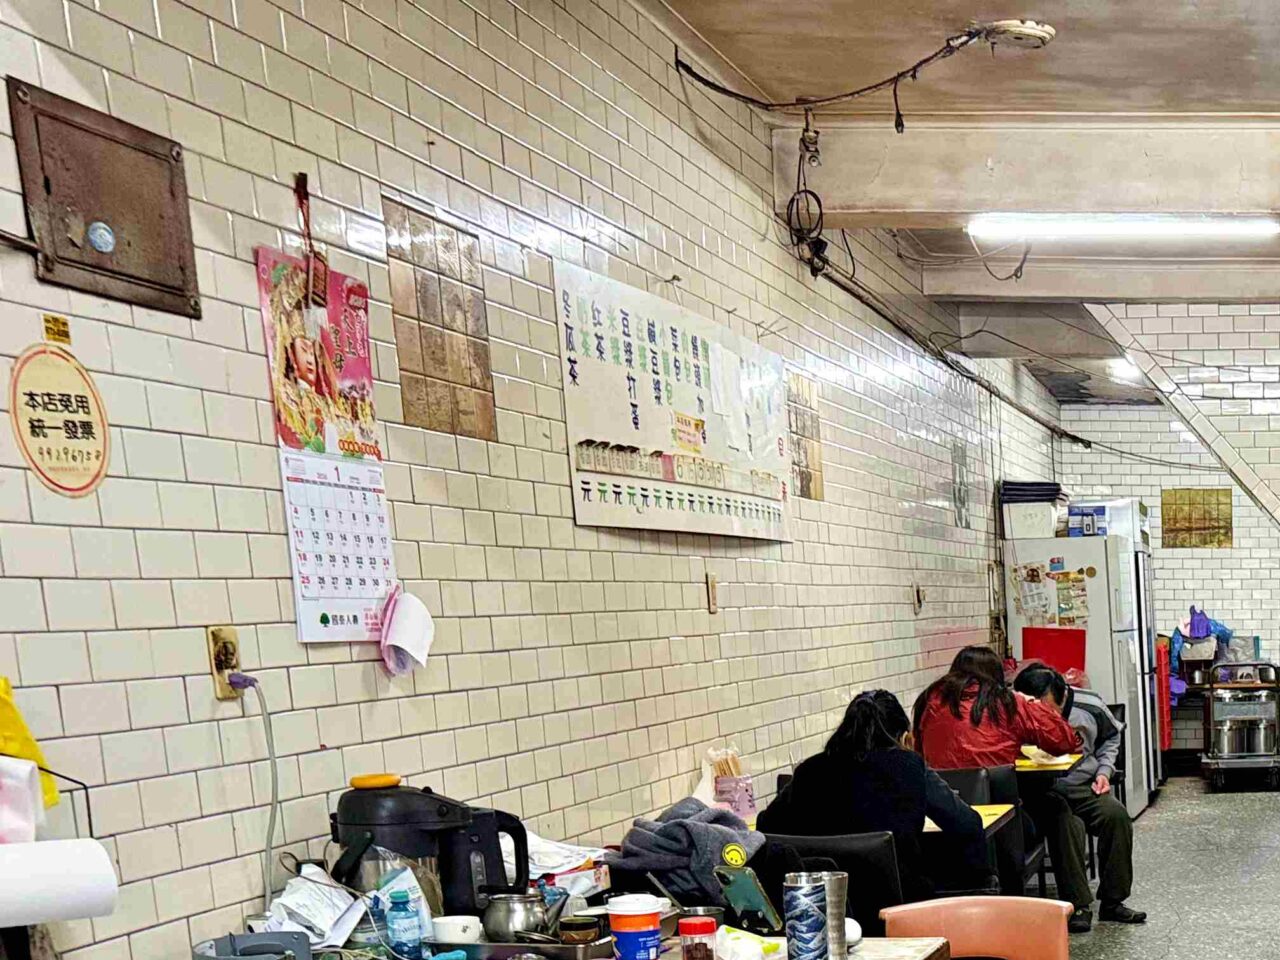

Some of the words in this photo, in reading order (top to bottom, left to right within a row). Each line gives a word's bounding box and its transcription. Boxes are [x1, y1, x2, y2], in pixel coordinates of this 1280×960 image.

[562, 289, 579, 386] 冬瓜茶
[591, 300, 606, 362] 紅茶
[23, 391, 91, 416] 本店免用
[28, 417, 96, 440] 統一發票
[333, 466, 341, 482] 1
[349, 491, 354, 500] 1
[362, 492, 367, 501] 2
[376, 494, 380, 502] 3
[581, 480, 591, 502] 元
[598, 482, 608, 503] 元
[612, 484, 622, 505] 元
[293, 507, 299, 515] 4
[310, 508, 315, 516] 5
[325, 510, 329, 518] 6
[338, 511, 342, 519] 7
[352, 513, 356, 521] 8
[365, 514, 370, 522] 9
[377, 516, 385, 524] 10
[295, 530, 304, 538] 11
[312, 532, 320, 540] 12
[326, 533, 334, 541] 13
[340, 534, 347, 542] 14
[354, 535, 361, 543] 15
[367, 536, 374, 544] 16
[380, 537, 387, 545] 17
[298, 553, 307, 561] 18
[315, 554, 323, 562] 19
[329, 555, 336, 563] 20
[342, 556, 350, 564] 21
[356, 556, 363, 565] 22
[369, 557, 377, 566] 23
[383, 558, 390, 566] 24
[301, 576, 310, 585] 25
[318, 576, 326, 585] 26
[331, 577, 338, 585] 27
[345, 577, 353, 586] 28
[359, 578, 366, 586] 29
[372, 578, 379, 587] 30
[385, 579, 392, 587] 31
